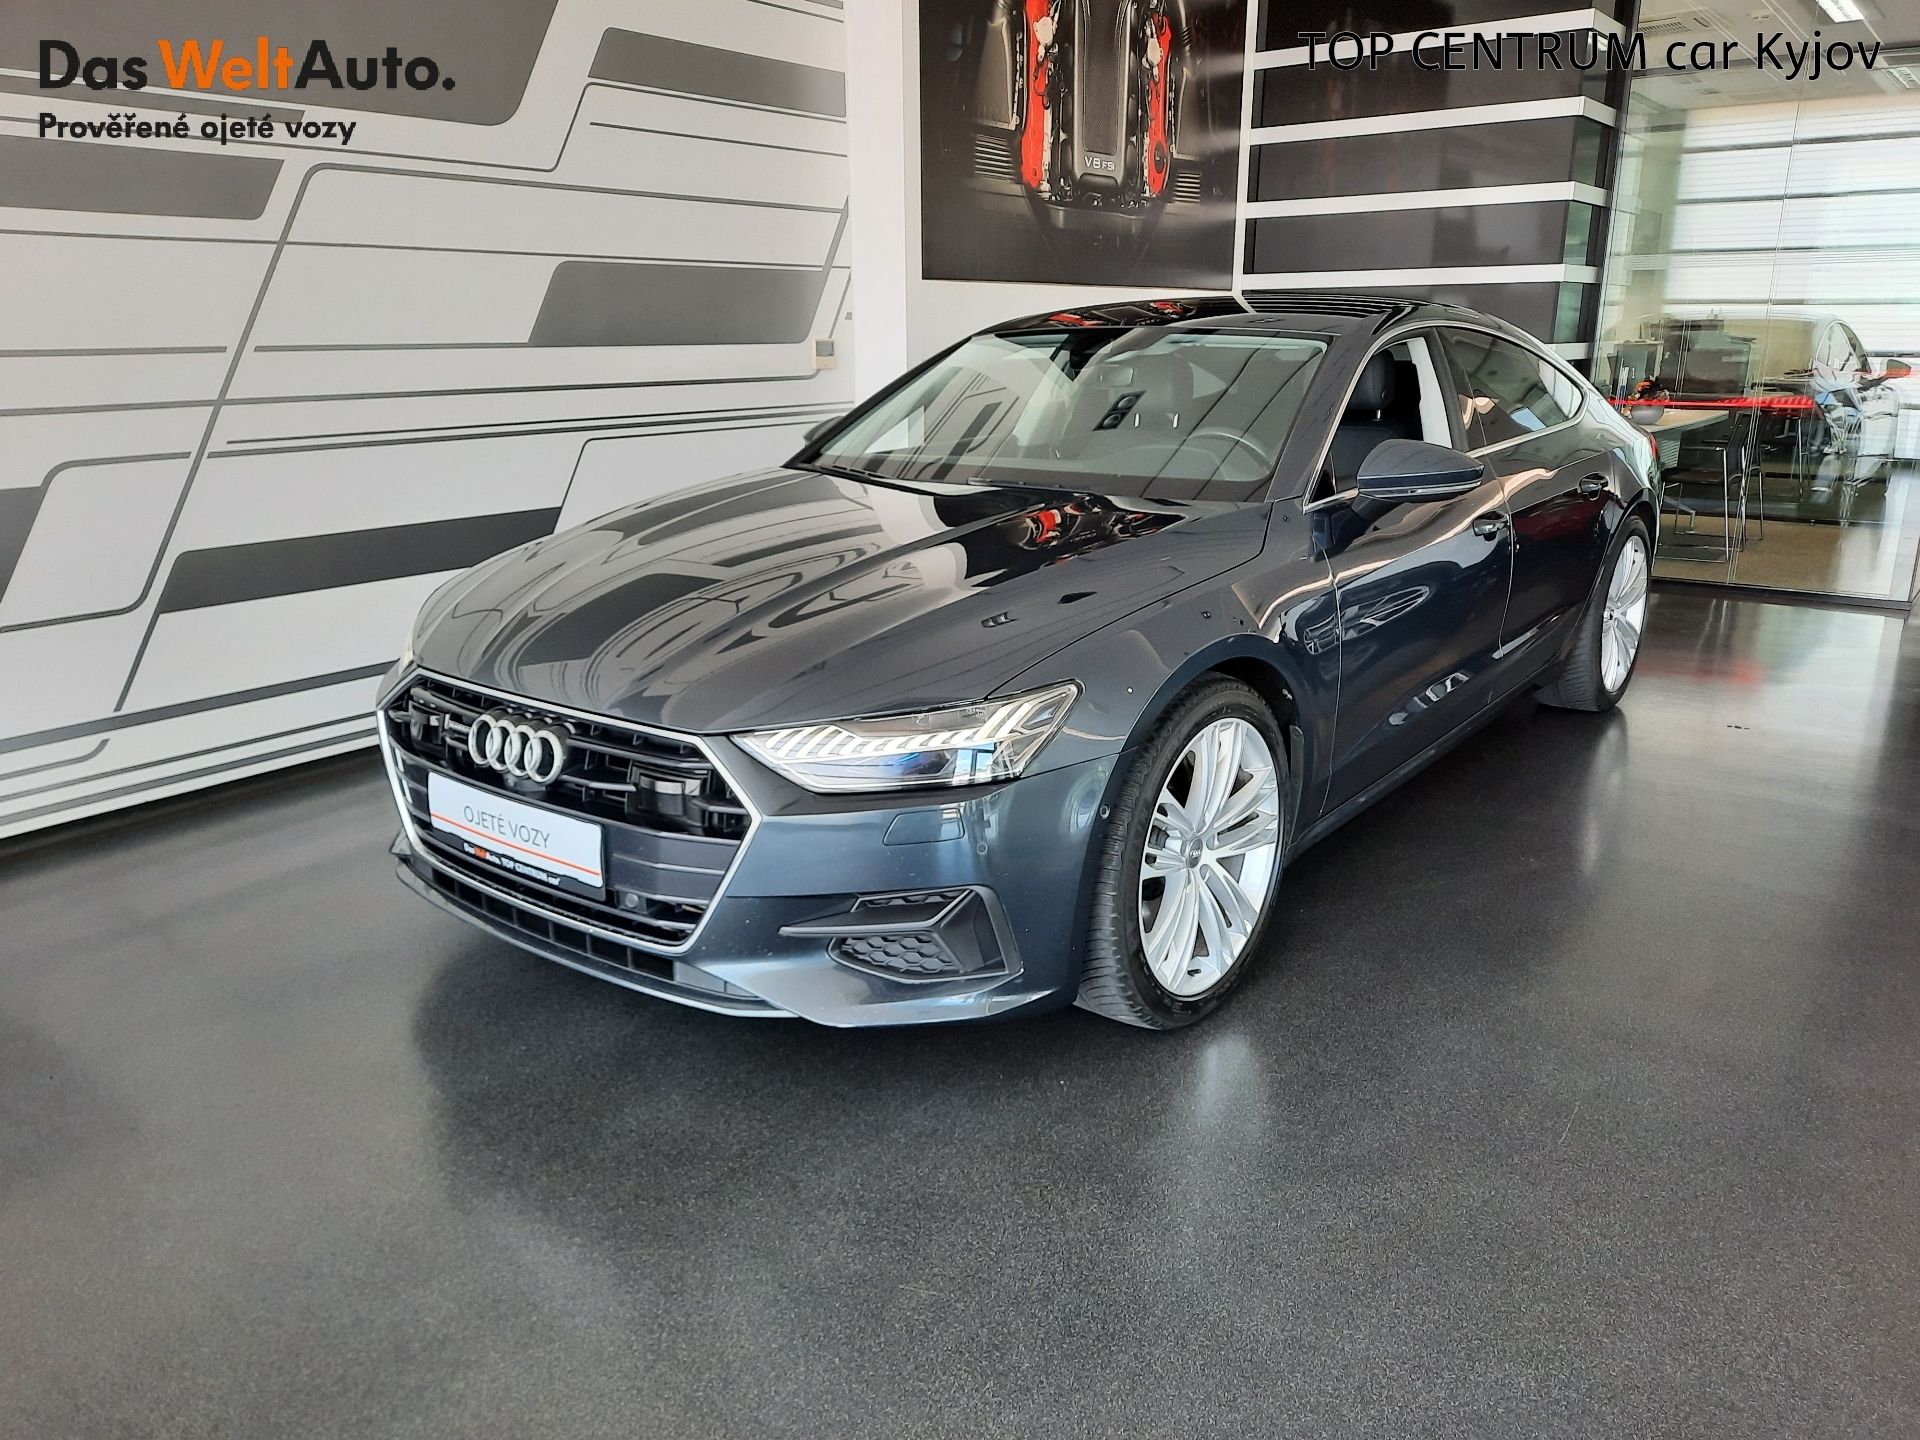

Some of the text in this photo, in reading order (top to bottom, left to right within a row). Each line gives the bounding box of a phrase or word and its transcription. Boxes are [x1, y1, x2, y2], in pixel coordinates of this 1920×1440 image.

[1084, 155, 1101, 169] V8
[463, 805, 550, 849] OJETÉ VOZY
